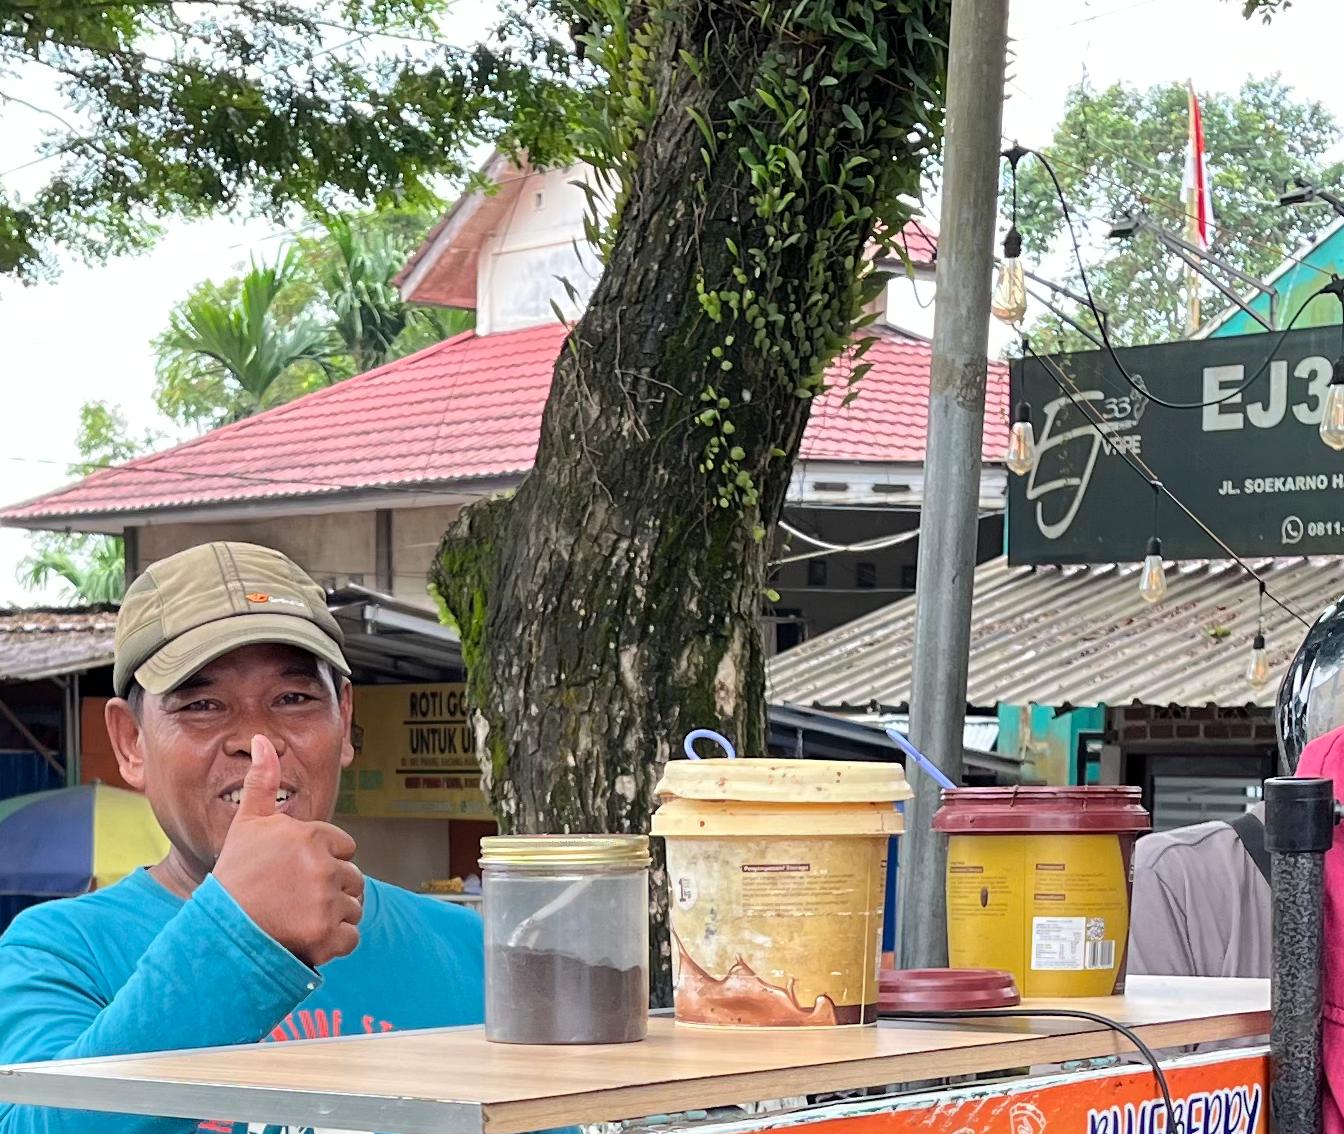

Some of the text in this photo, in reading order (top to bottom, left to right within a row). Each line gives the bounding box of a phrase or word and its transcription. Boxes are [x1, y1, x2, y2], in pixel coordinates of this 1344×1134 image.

[1218, 480, 1241, 496] JL.
[1244, 474, 1329, 494] SOEKARNO
[409, 691, 443, 718] ROTI
[410, 727, 457, 754] UNTUK
